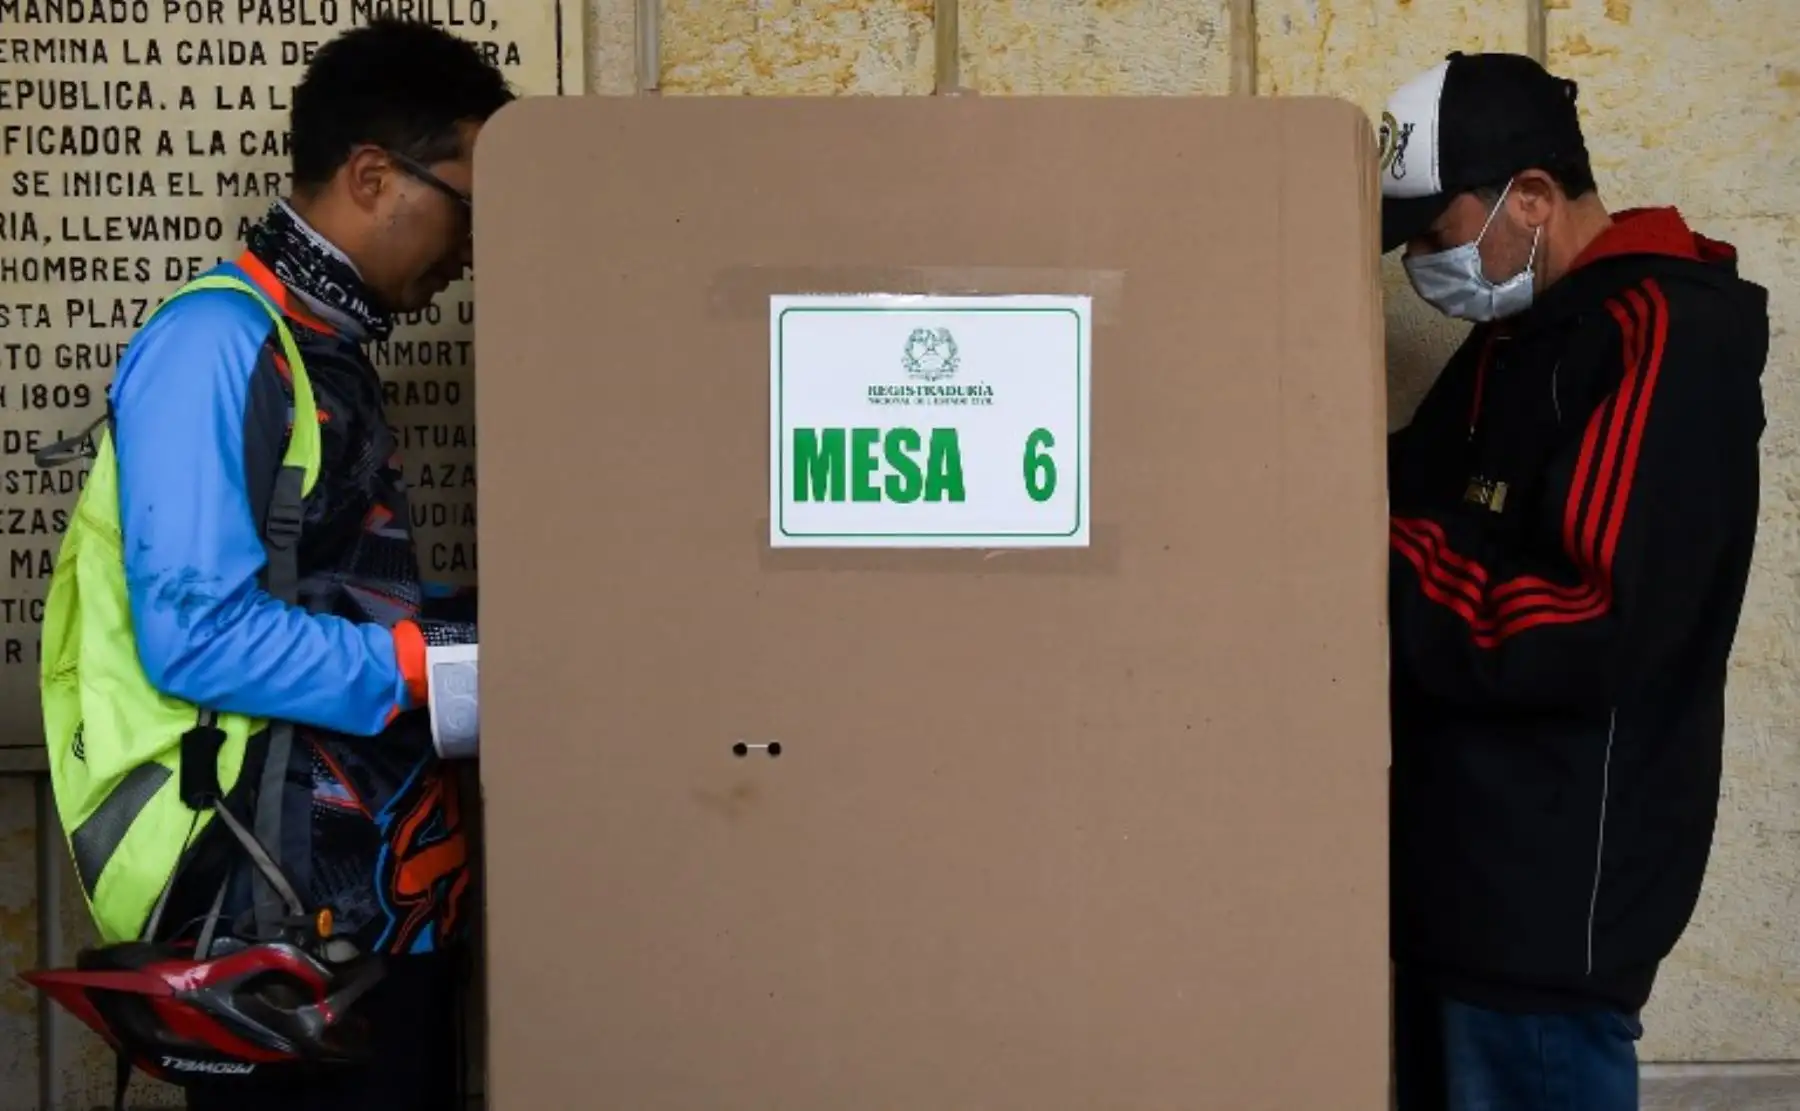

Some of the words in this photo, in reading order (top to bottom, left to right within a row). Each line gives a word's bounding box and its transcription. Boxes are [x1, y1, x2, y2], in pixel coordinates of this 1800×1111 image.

[0, 0, 148, 23] MANDADO
[164, 0, 224, 24] POR
[239, 0, 337, 25] PABLO
[123, 39, 161, 65] LA
[176, 40, 267, 65] CAIDA
[470, 42, 520, 65] RA
[179, 85, 195, 110] A
[216, 85, 255, 110] LA
[269, 85, 297, 110] L
[3, 125, 141, 155] FICADOR
[157, 130, 173, 156] A
[188, 130, 225, 156] LA
[12, 171, 50, 197] SE
[64, 171, 155, 197] INICIA
[168, 172, 203, 197] EL
[61, 216, 223, 241] LLEVANDO
[1, 257, 151, 283] HOMBRES
[66, 298, 164, 328] PLAZ
[22, 384, 91, 409] 1809
[4, 430, 42, 454] DE
[792, 427, 966, 503] MESA
[1023, 427, 1058, 502] 6
[160, 1055, 257, 1076] PROWELL
